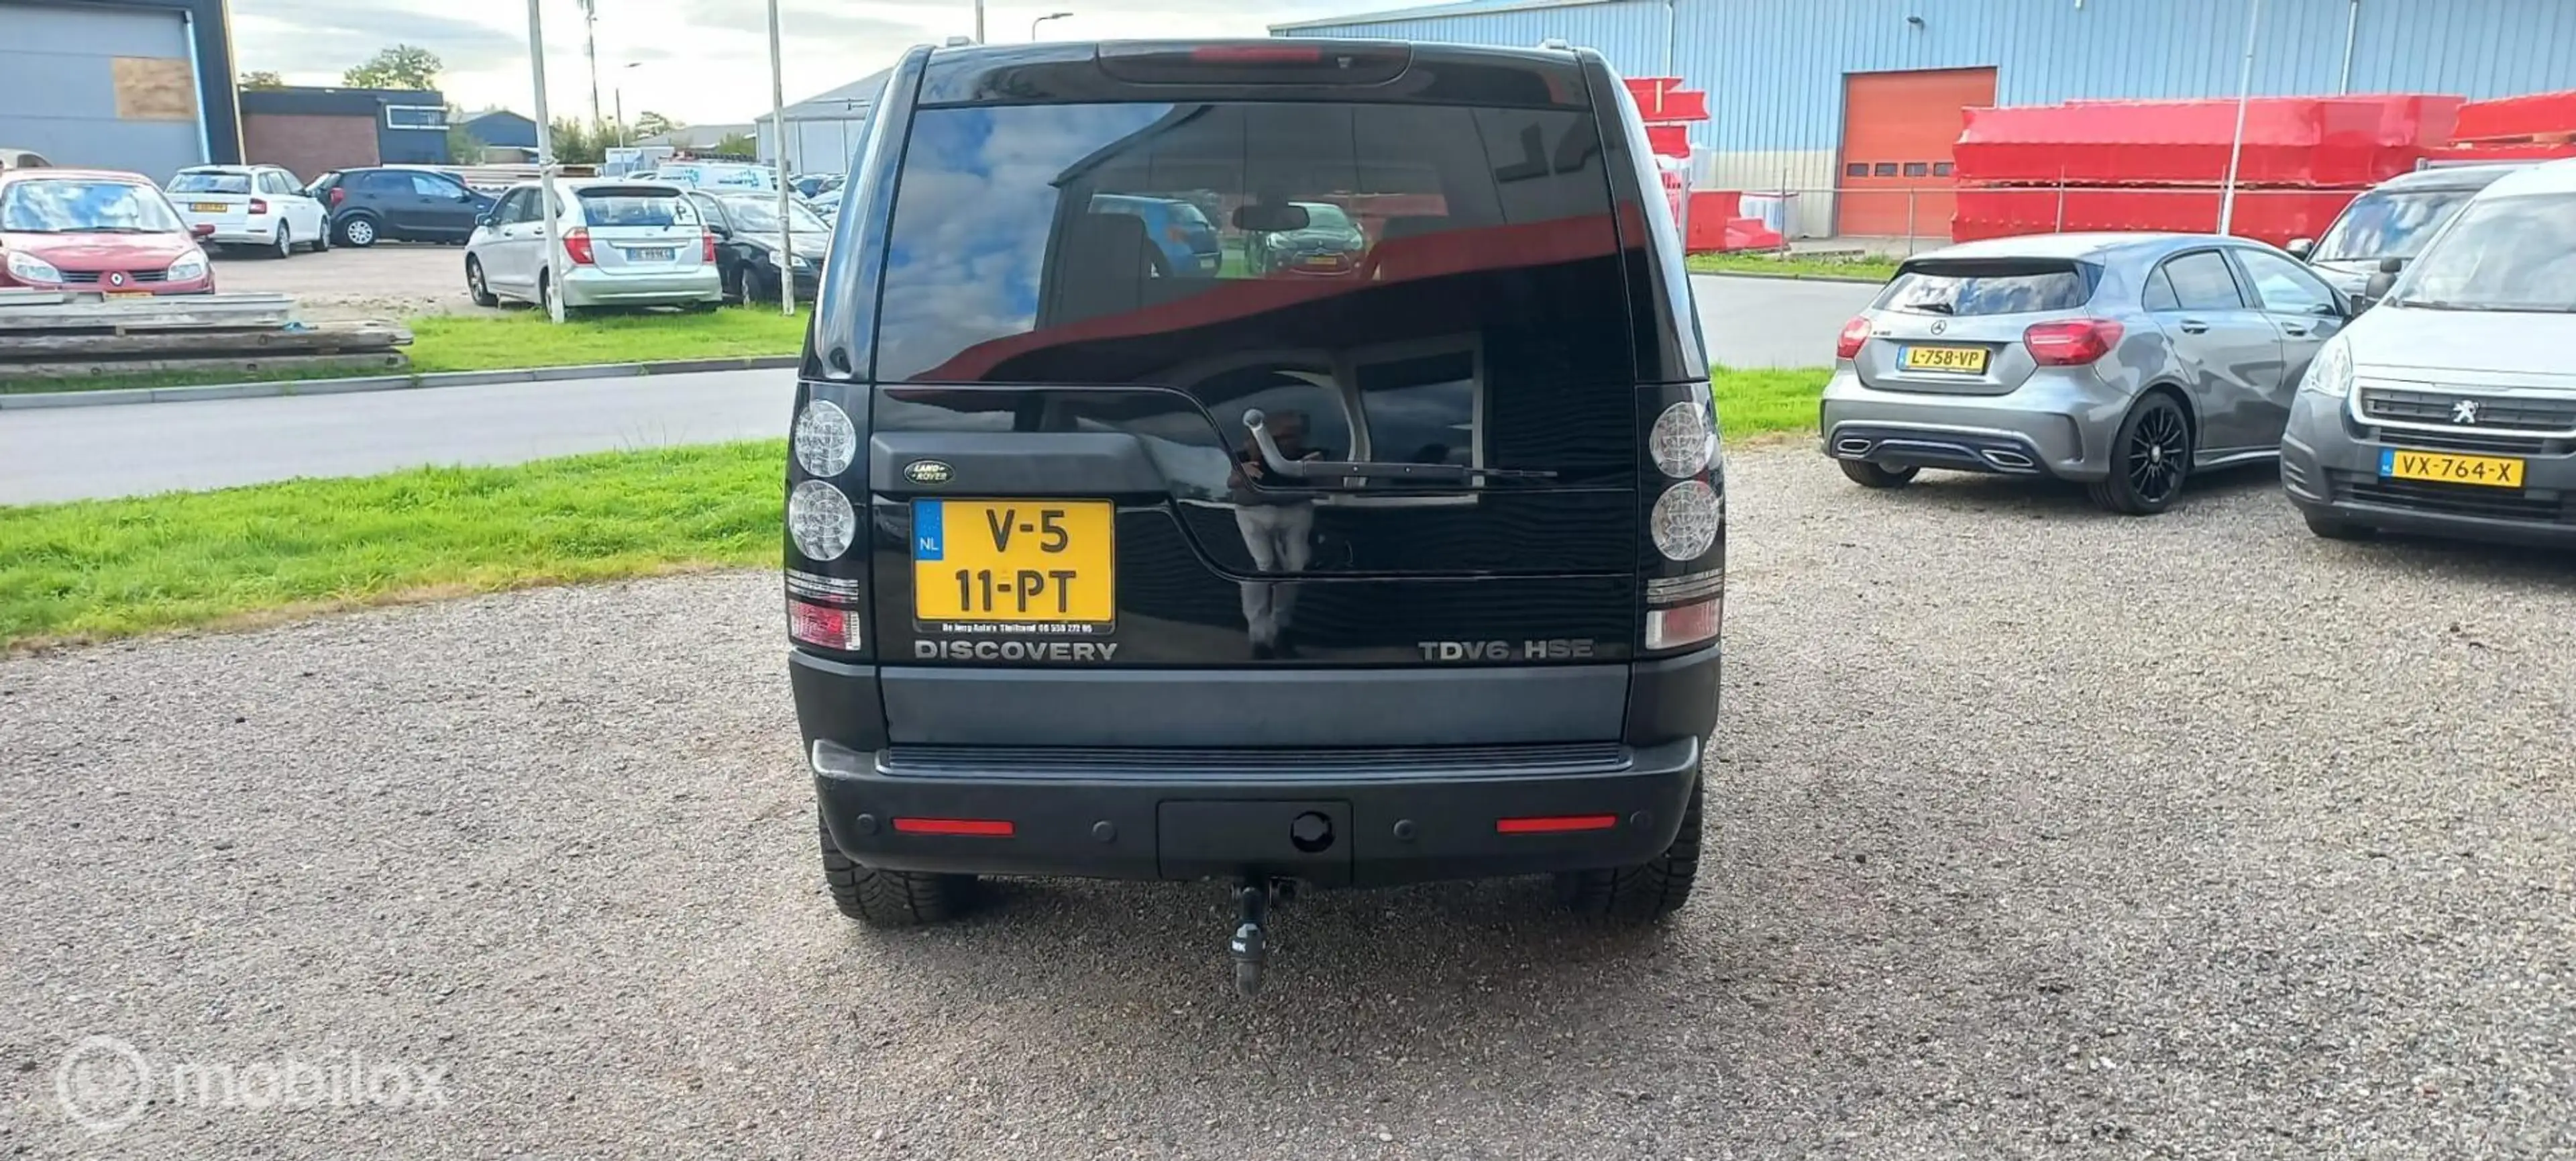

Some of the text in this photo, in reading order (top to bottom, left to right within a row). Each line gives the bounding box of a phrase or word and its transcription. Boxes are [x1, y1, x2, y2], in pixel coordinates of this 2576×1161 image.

[1912, 349, 1979, 366] L-758-VP
[2403, 456, 2512, 482] VX-764-X
[985, 509, 1069, 553] V-5
[920, 536, 939, 550] NL
[955, 568, 1077, 613] 11-PT
[914, 640, 1118, 661] DISCOVERY
[1417, 639, 1594, 661] TDV6 HSE
